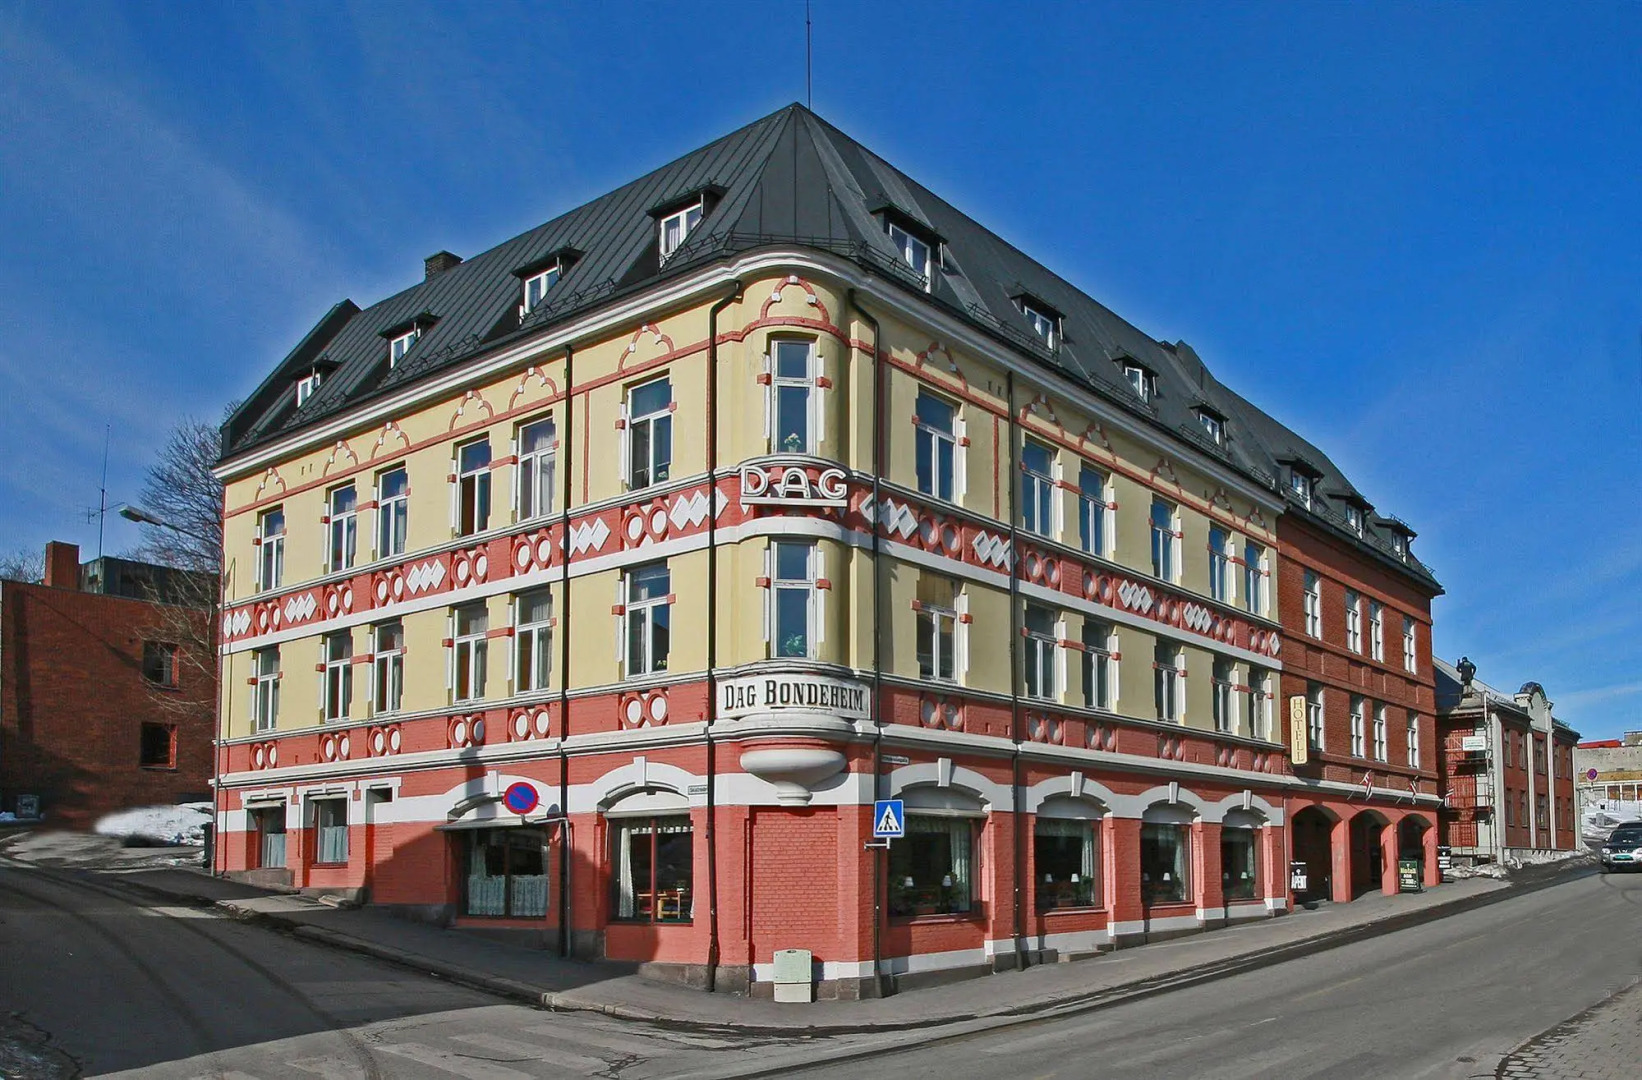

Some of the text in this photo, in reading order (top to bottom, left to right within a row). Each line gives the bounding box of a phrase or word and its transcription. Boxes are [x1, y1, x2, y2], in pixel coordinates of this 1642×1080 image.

[741, 466, 847, 499] DAG
[724, 680, 864, 712] DAG BONDEHEIM
[1293, 698, 1304, 761] HOTELL
